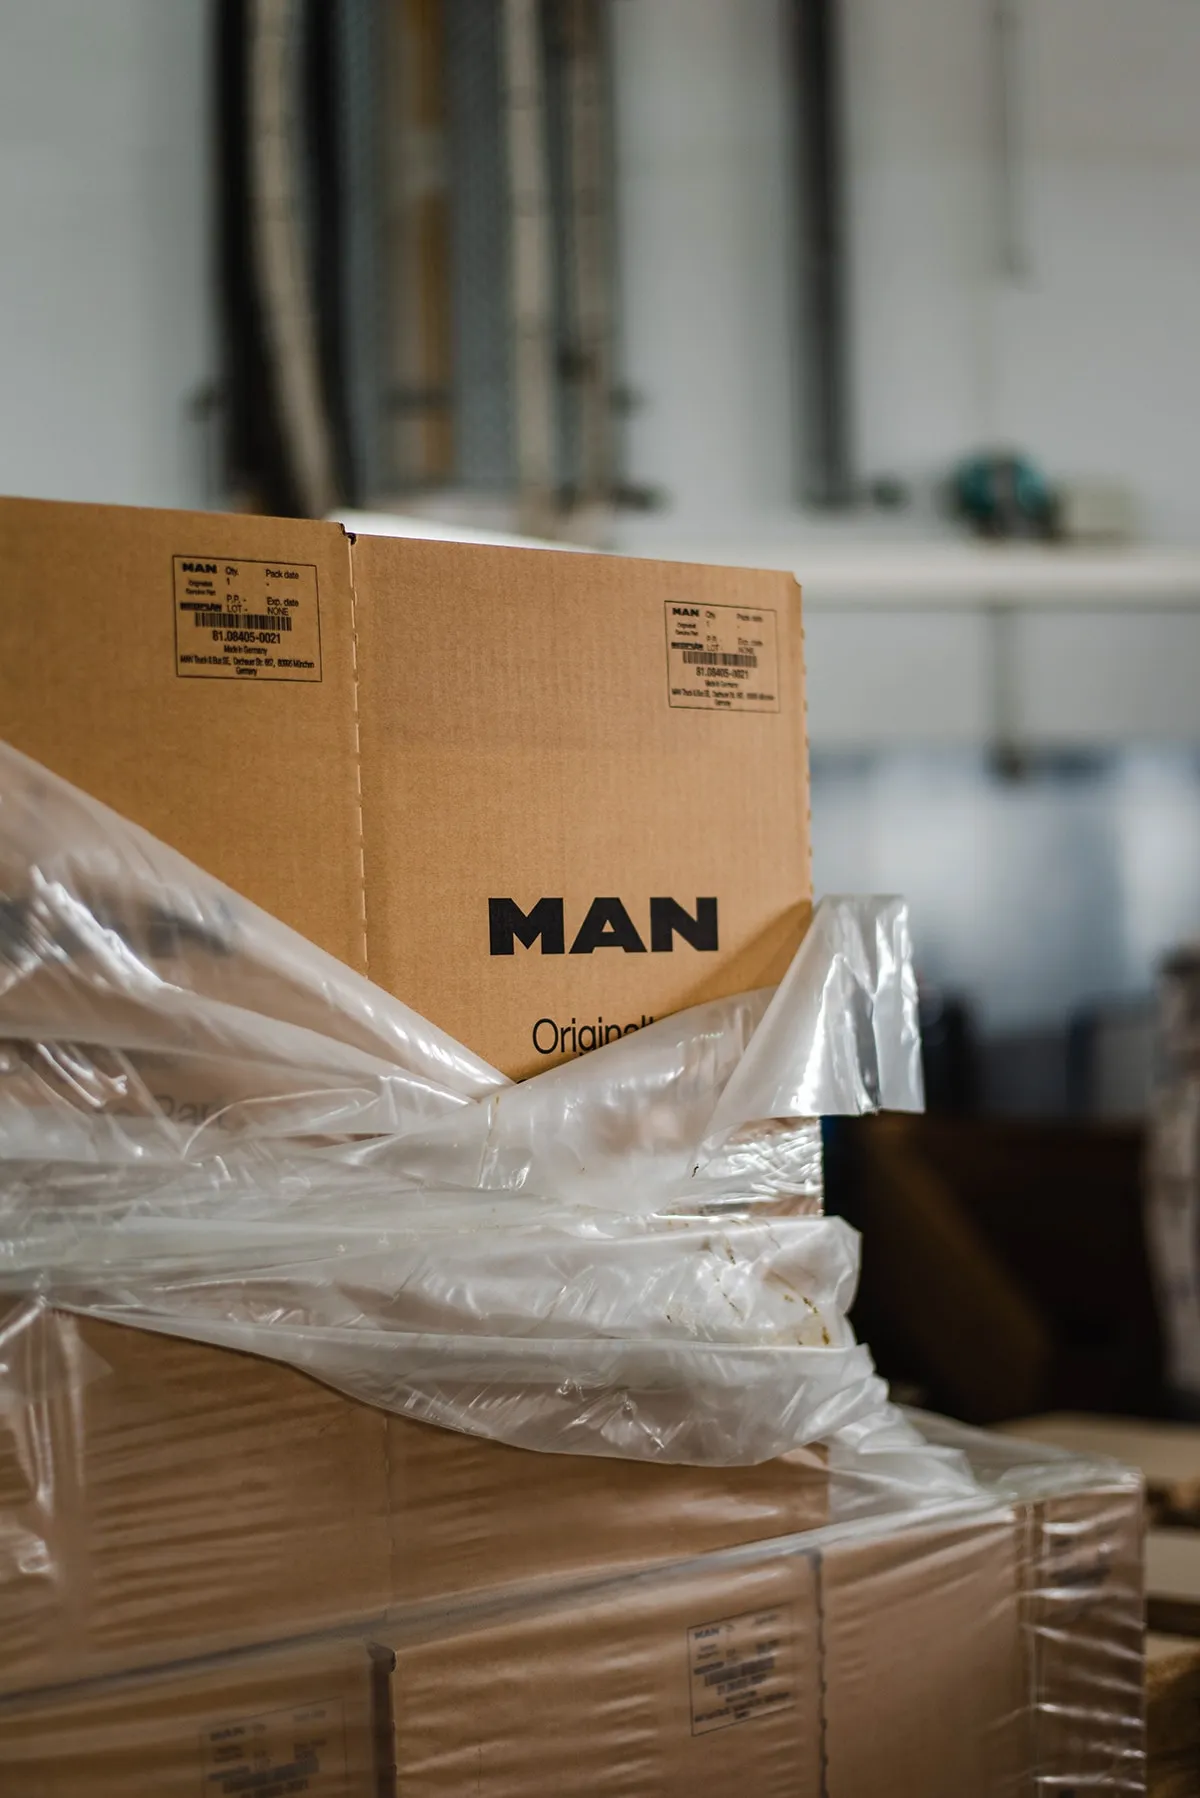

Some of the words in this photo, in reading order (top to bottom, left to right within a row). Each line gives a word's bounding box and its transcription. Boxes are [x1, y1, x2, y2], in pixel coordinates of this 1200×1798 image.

[182, 563, 217, 574] MAN
[266, 569, 283, 578] Pack
[284, 570, 299, 579] date
[267, 597, 282, 607] Exp.
[284, 598, 299, 607] date
[227, 605, 241, 613] LOT
[267, 607, 288, 615] NONE
[672, 608, 699, 617] MAN
[212, 631, 281, 644] 81.08405-0021
[244, 646, 267, 656] Germany
[488, 897, 719, 956] MAN
